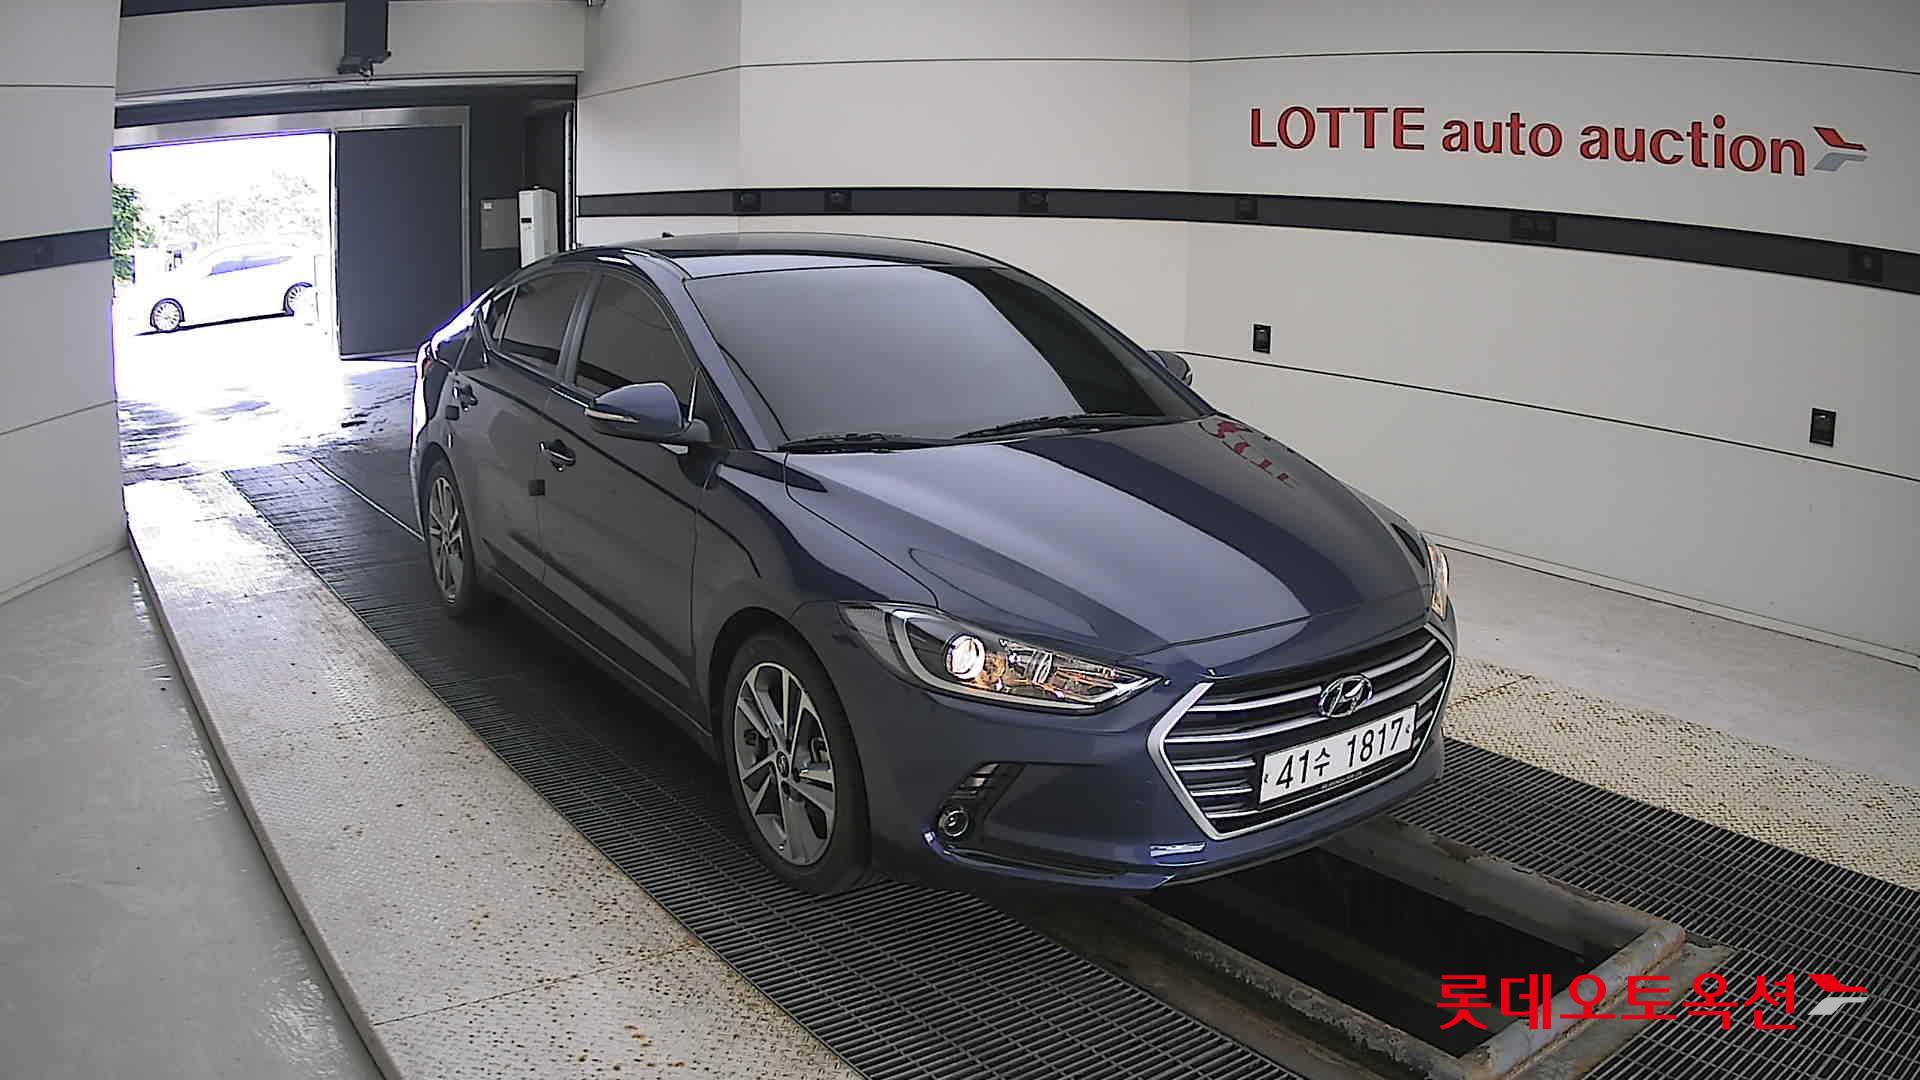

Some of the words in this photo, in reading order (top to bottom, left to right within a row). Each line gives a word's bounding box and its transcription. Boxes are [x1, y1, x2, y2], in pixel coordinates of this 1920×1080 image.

[1250, 105, 1425, 151] LOTTE
[1441, 111, 1563, 157] auto
[1579, 115, 1806, 177] auction
[1276, 748, 1331, 789] 41수
[1347, 717, 1404, 767] 1817
